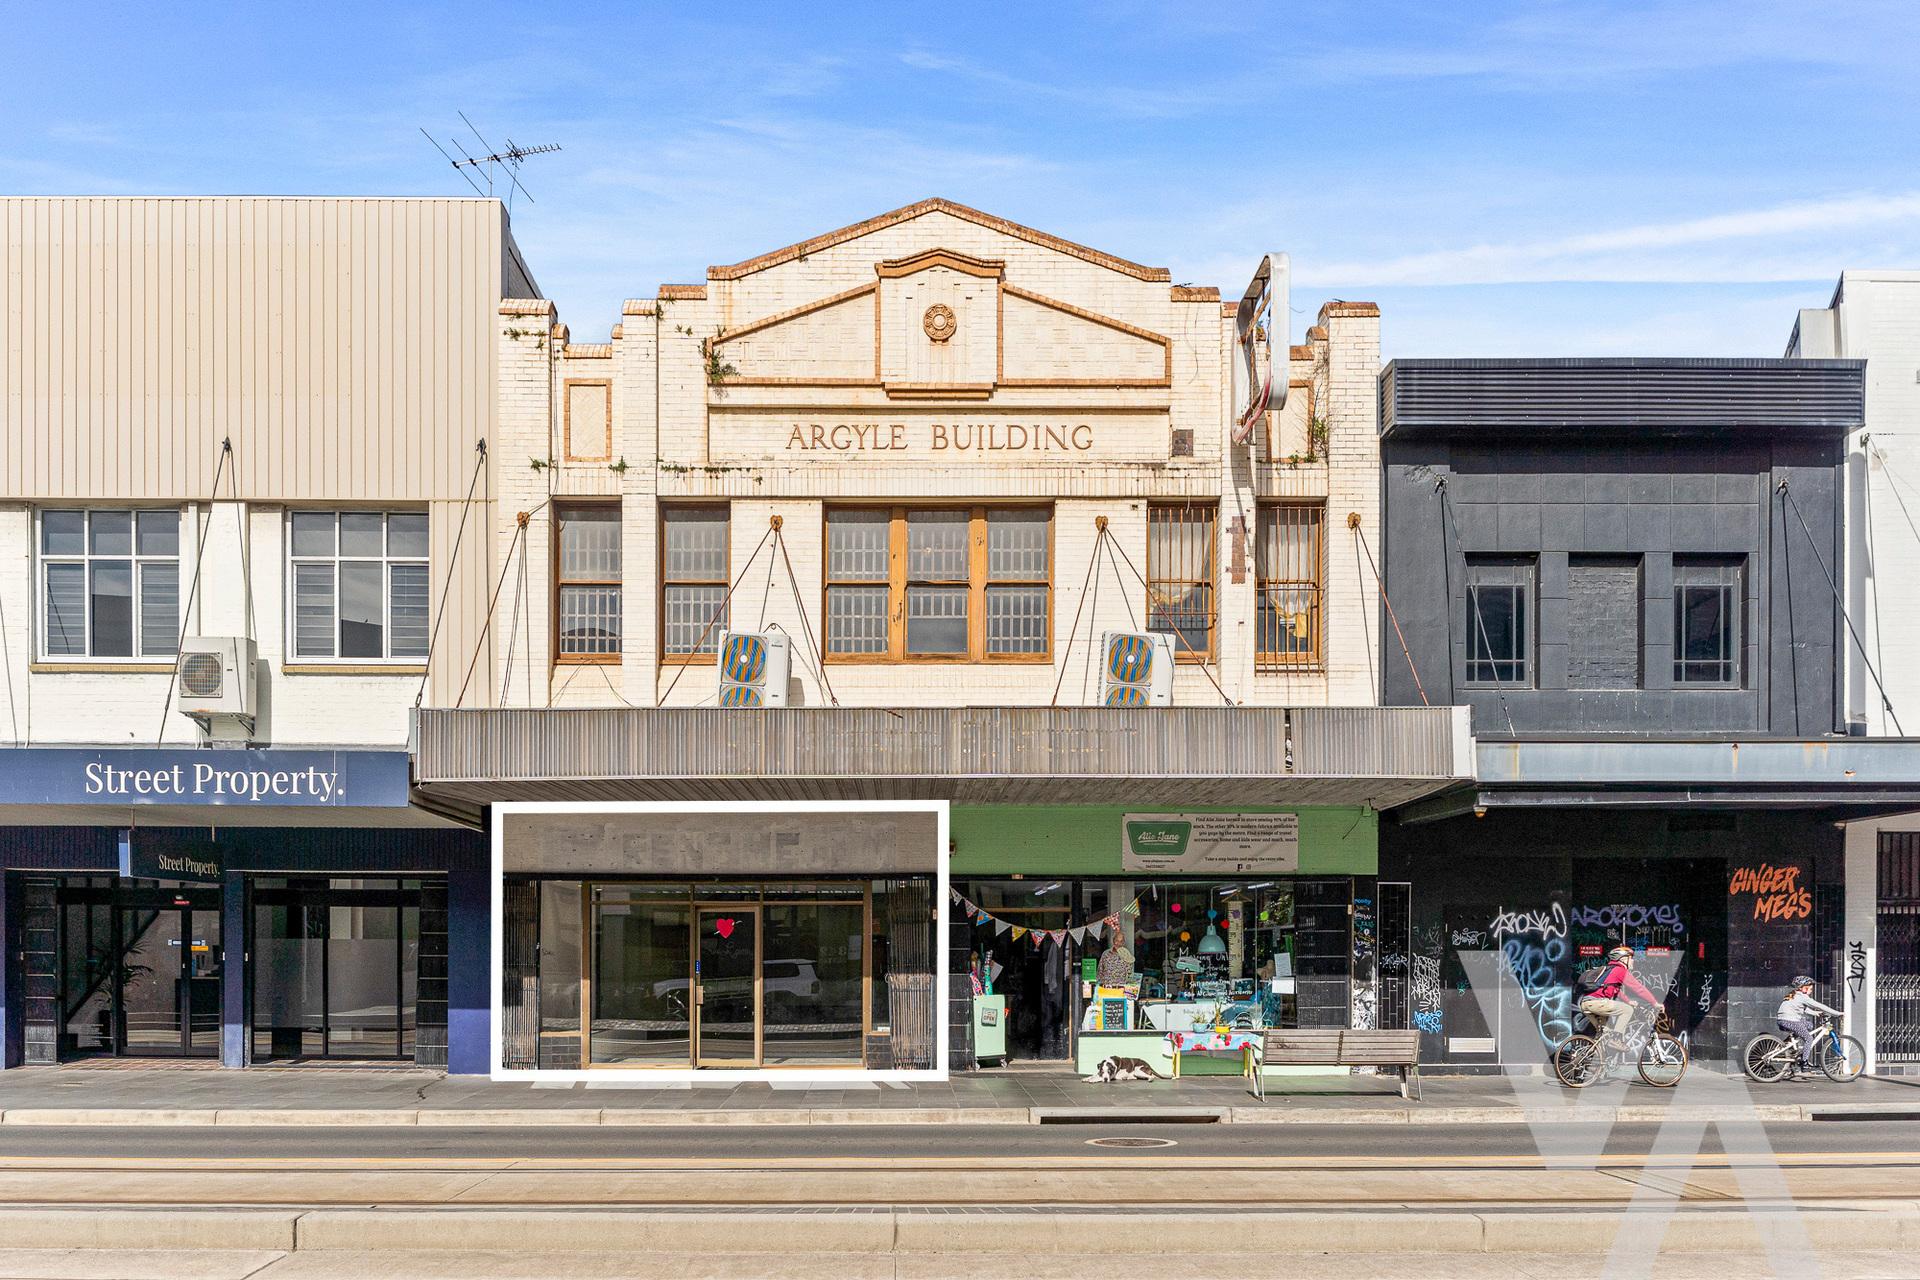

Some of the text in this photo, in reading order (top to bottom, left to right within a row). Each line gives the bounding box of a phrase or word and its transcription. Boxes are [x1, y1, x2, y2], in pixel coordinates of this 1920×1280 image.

[785, 424, 1094, 451] ARGYLE BUILDING
[85, 762, 345, 802] Street Property.
[158, 854, 220, 878] Street Property.
[1729, 863, 1800, 896] GINGER
[1753, 887, 1812, 923] MEG'S
